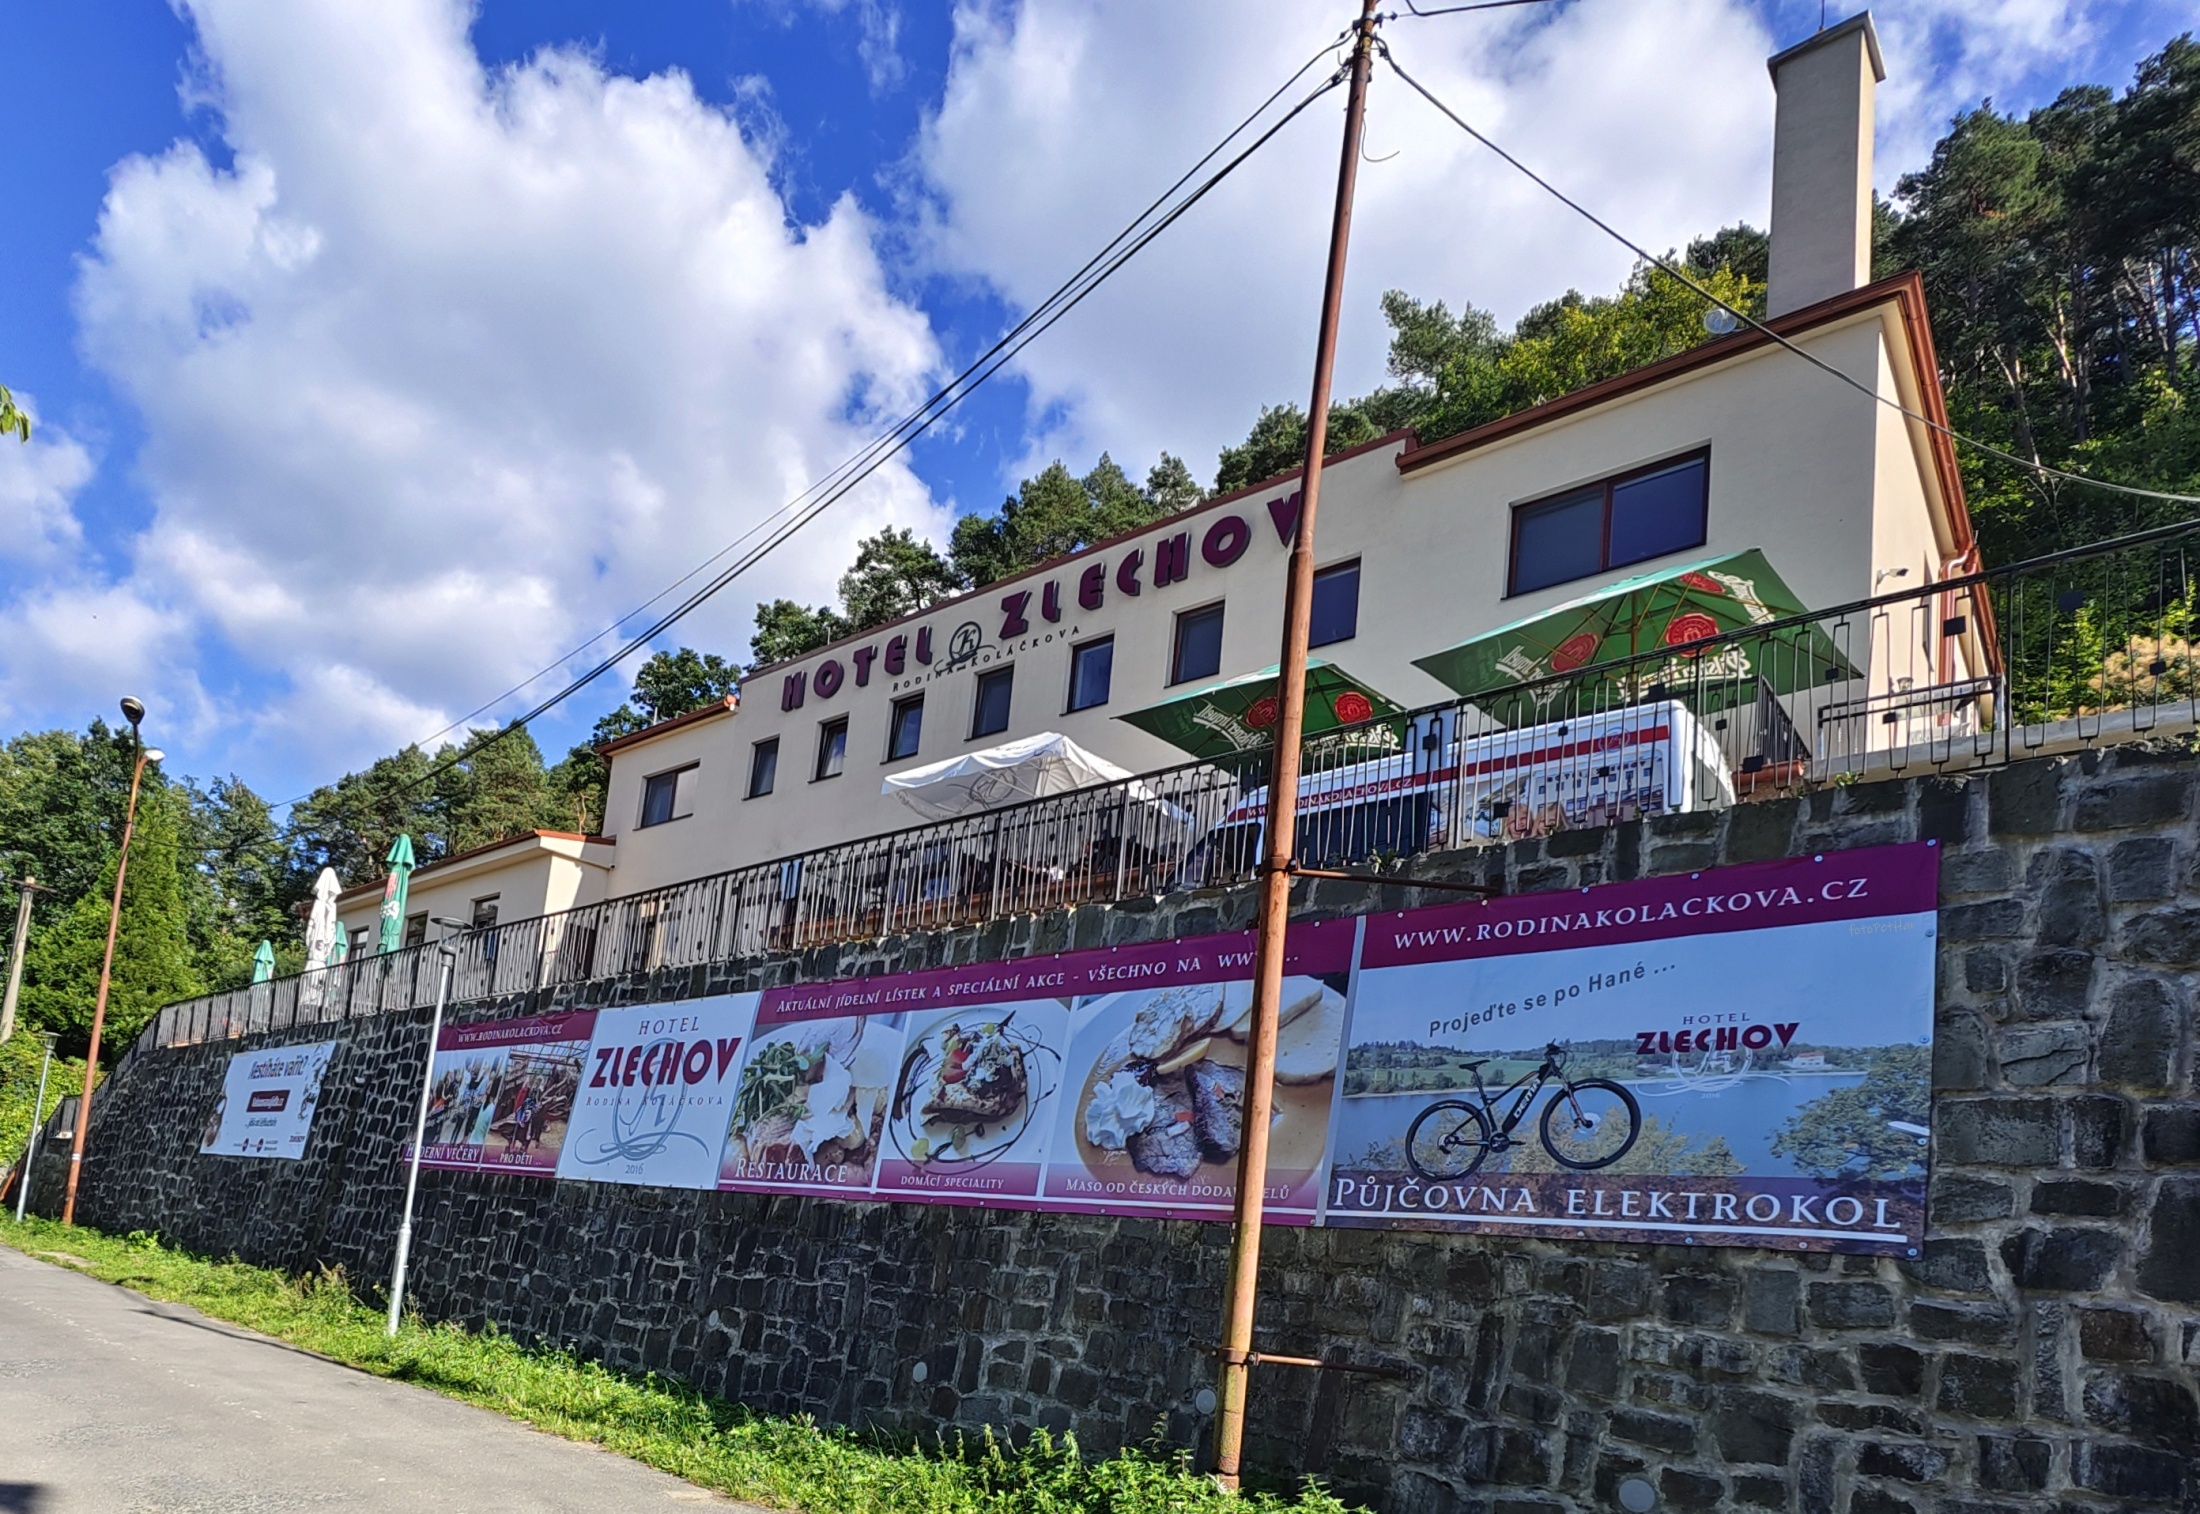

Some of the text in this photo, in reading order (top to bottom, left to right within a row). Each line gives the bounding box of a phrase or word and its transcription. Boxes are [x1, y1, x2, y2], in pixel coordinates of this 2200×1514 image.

[781, 491, 1301, 712] HOTEL ZLECHOV
[893, 626, 1080, 692] RODINA KOLÁČKOVA
[1394, 878, 1869, 949] WWW.RODINAKOLACKOVA.CZ
[776, 997, 832, 1013] AKTUÁLNÍ
[835, 989, 881, 1009] JÍDELNÍ
[885, 986, 927, 1002] LÍSTEK
[932, 986, 941, 998] A
[947, 973, 1019, 996] SPECIÁLNÍ
[1026, 972, 1065, 988] AKCE
[1088, 961, 1167, 982] VŠECHNO
[1176, 957, 1202, 973] NA
[1429, 999, 1517, 1037] Projeďte
[1524, 993, 1547, 1011] se
[1554, 982, 1581, 1007] po
[1589, 961, 1646, 993] Hané
[638, 1016, 700, 1036] HOTEL
[1683, 1012, 1751, 1026] HOTEL
[1636, 1022, 1800, 1055] ZLECHOV
[588, 1037, 743, 1088] ZLECHOV
[586, 1096, 631, 1106] RODINA
[406, 1143, 481, 1162] HDEBNÍ VEČERY
[500, 1152, 533, 1165] PRO DĚTI
[625, 1162, 645, 1175] 2016
[735, 1158, 848, 1183] RESTAURACE
[900, 1173, 1005, 1189] DOMÁCÍ SPECIALITY
[1066, 1178, 1290, 1200] MASO OD ČESKÝCH DODAELŮ
[1334, 1175, 1902, 1229] PŮJČOVNA ELEKTROKOL
